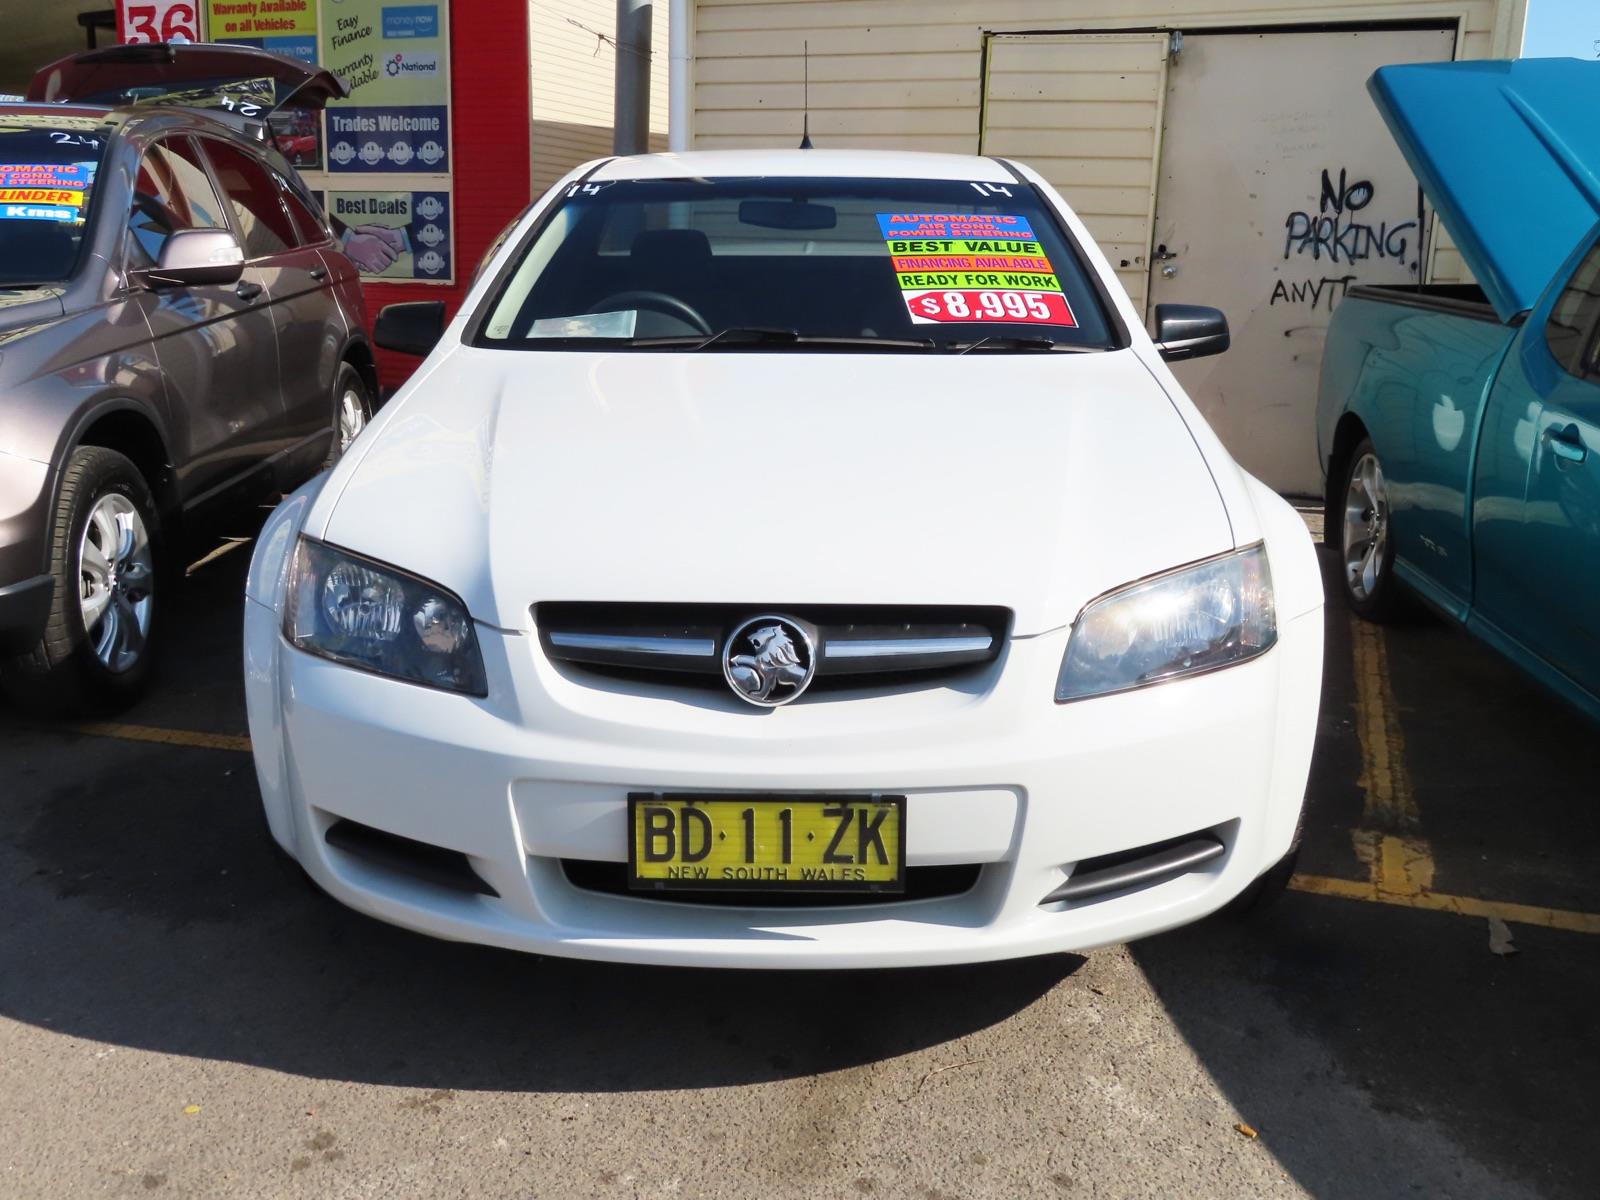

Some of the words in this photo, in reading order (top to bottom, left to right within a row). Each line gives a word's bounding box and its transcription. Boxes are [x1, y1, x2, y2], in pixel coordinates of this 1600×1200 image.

[213, 2, 257, 16] Warranty
[260, 0, 306, 13] Available
[128, 4, 195, 44] 36
[225, 22, 237, 32] on
[240, 19, 252, 32] all
[254, 18, 296, 31] Vehicles
[337, 16, 359, 31] Easy
[415, 15, 433, 24] now
[331, 26, 372, 50] Finance
[401, 61, 436, 72] National
[332, 116, 376, 132] Trades
[378, 115, 440, 131] Welcome
[50, 132, 99, 150] 24
[9, 179, 84, 187] STEERING
[969, 182, 1013, 197] 14
[1319, 167, 1374, 215] NO
[6, 206, 71, 218] Kms
[336, 198, 367, 214] Best
[369, 198, 407, 215] Deals
[890, 215, 1017, 225] AUTOMATIC
[950, 223, 1000, 231] COND.
[951, 230, 1033, 239] STEERING
[1284, 212, 1416, 266] PARKING
[893, 241, 954, 253] BEST
[964, 241, 1038, 254] VALUE
[897, 258, 970, 269] FINANCING
[975, 258, 1048, 270] AVAILABLE
[901, 274, 959, 287] READY
[964, 274, 1000, 286] FOR
[1005, 275, 1056, 288] WORK
[668, 866, 709, 880] NEW
[723, 867, 788, 881] SOUTH
[801, 867, 865, 881] WALES
